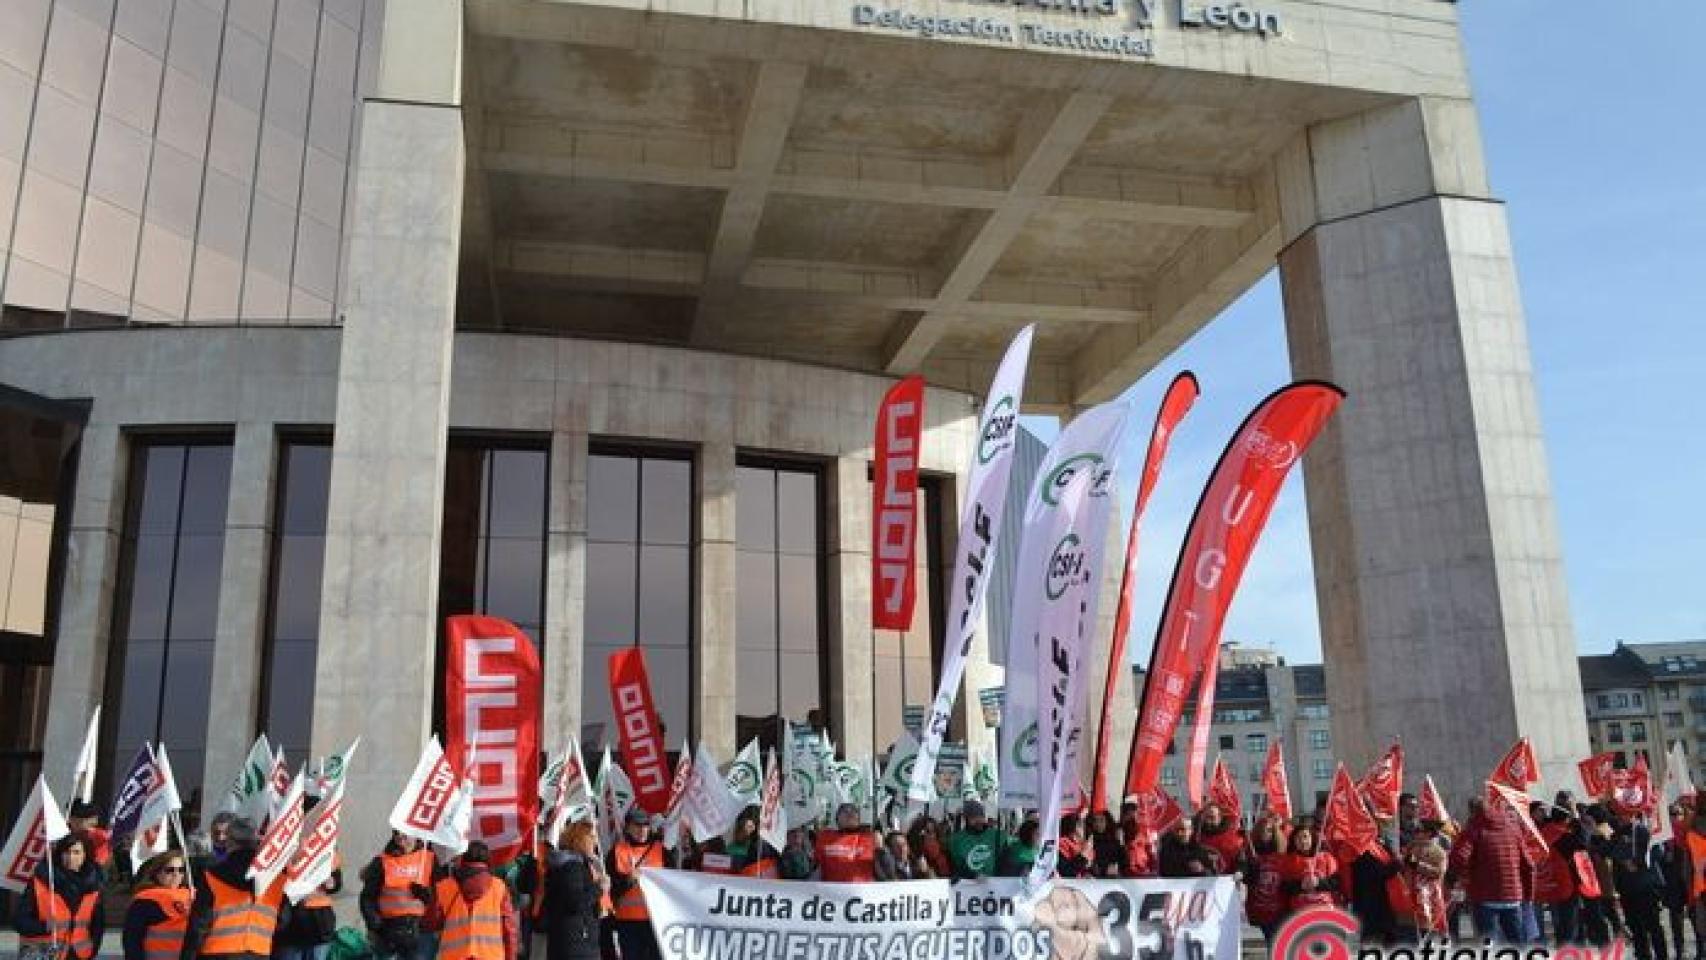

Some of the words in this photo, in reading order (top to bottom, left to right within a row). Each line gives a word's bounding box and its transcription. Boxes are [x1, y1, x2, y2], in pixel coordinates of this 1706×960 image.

[852, 5, 1012, 42] Delegación
[1020, 24, 1154, 57] Territorial
[1179, 0, 1282, 38] León
[464, 637, 518, 852] CCOO
[708, 888, 793, 919] Junta
[801, 896, 836, 922] de
[844, 893, 933, 923] Castilla
[936, 897, 949, 926] y
[955, 891, 1015, 917] León
[662, 923, 811, 960] CUMPLE
[815, 931, 882, 960] TUS
[883, 927, 1052, 960] ACUERDOS
